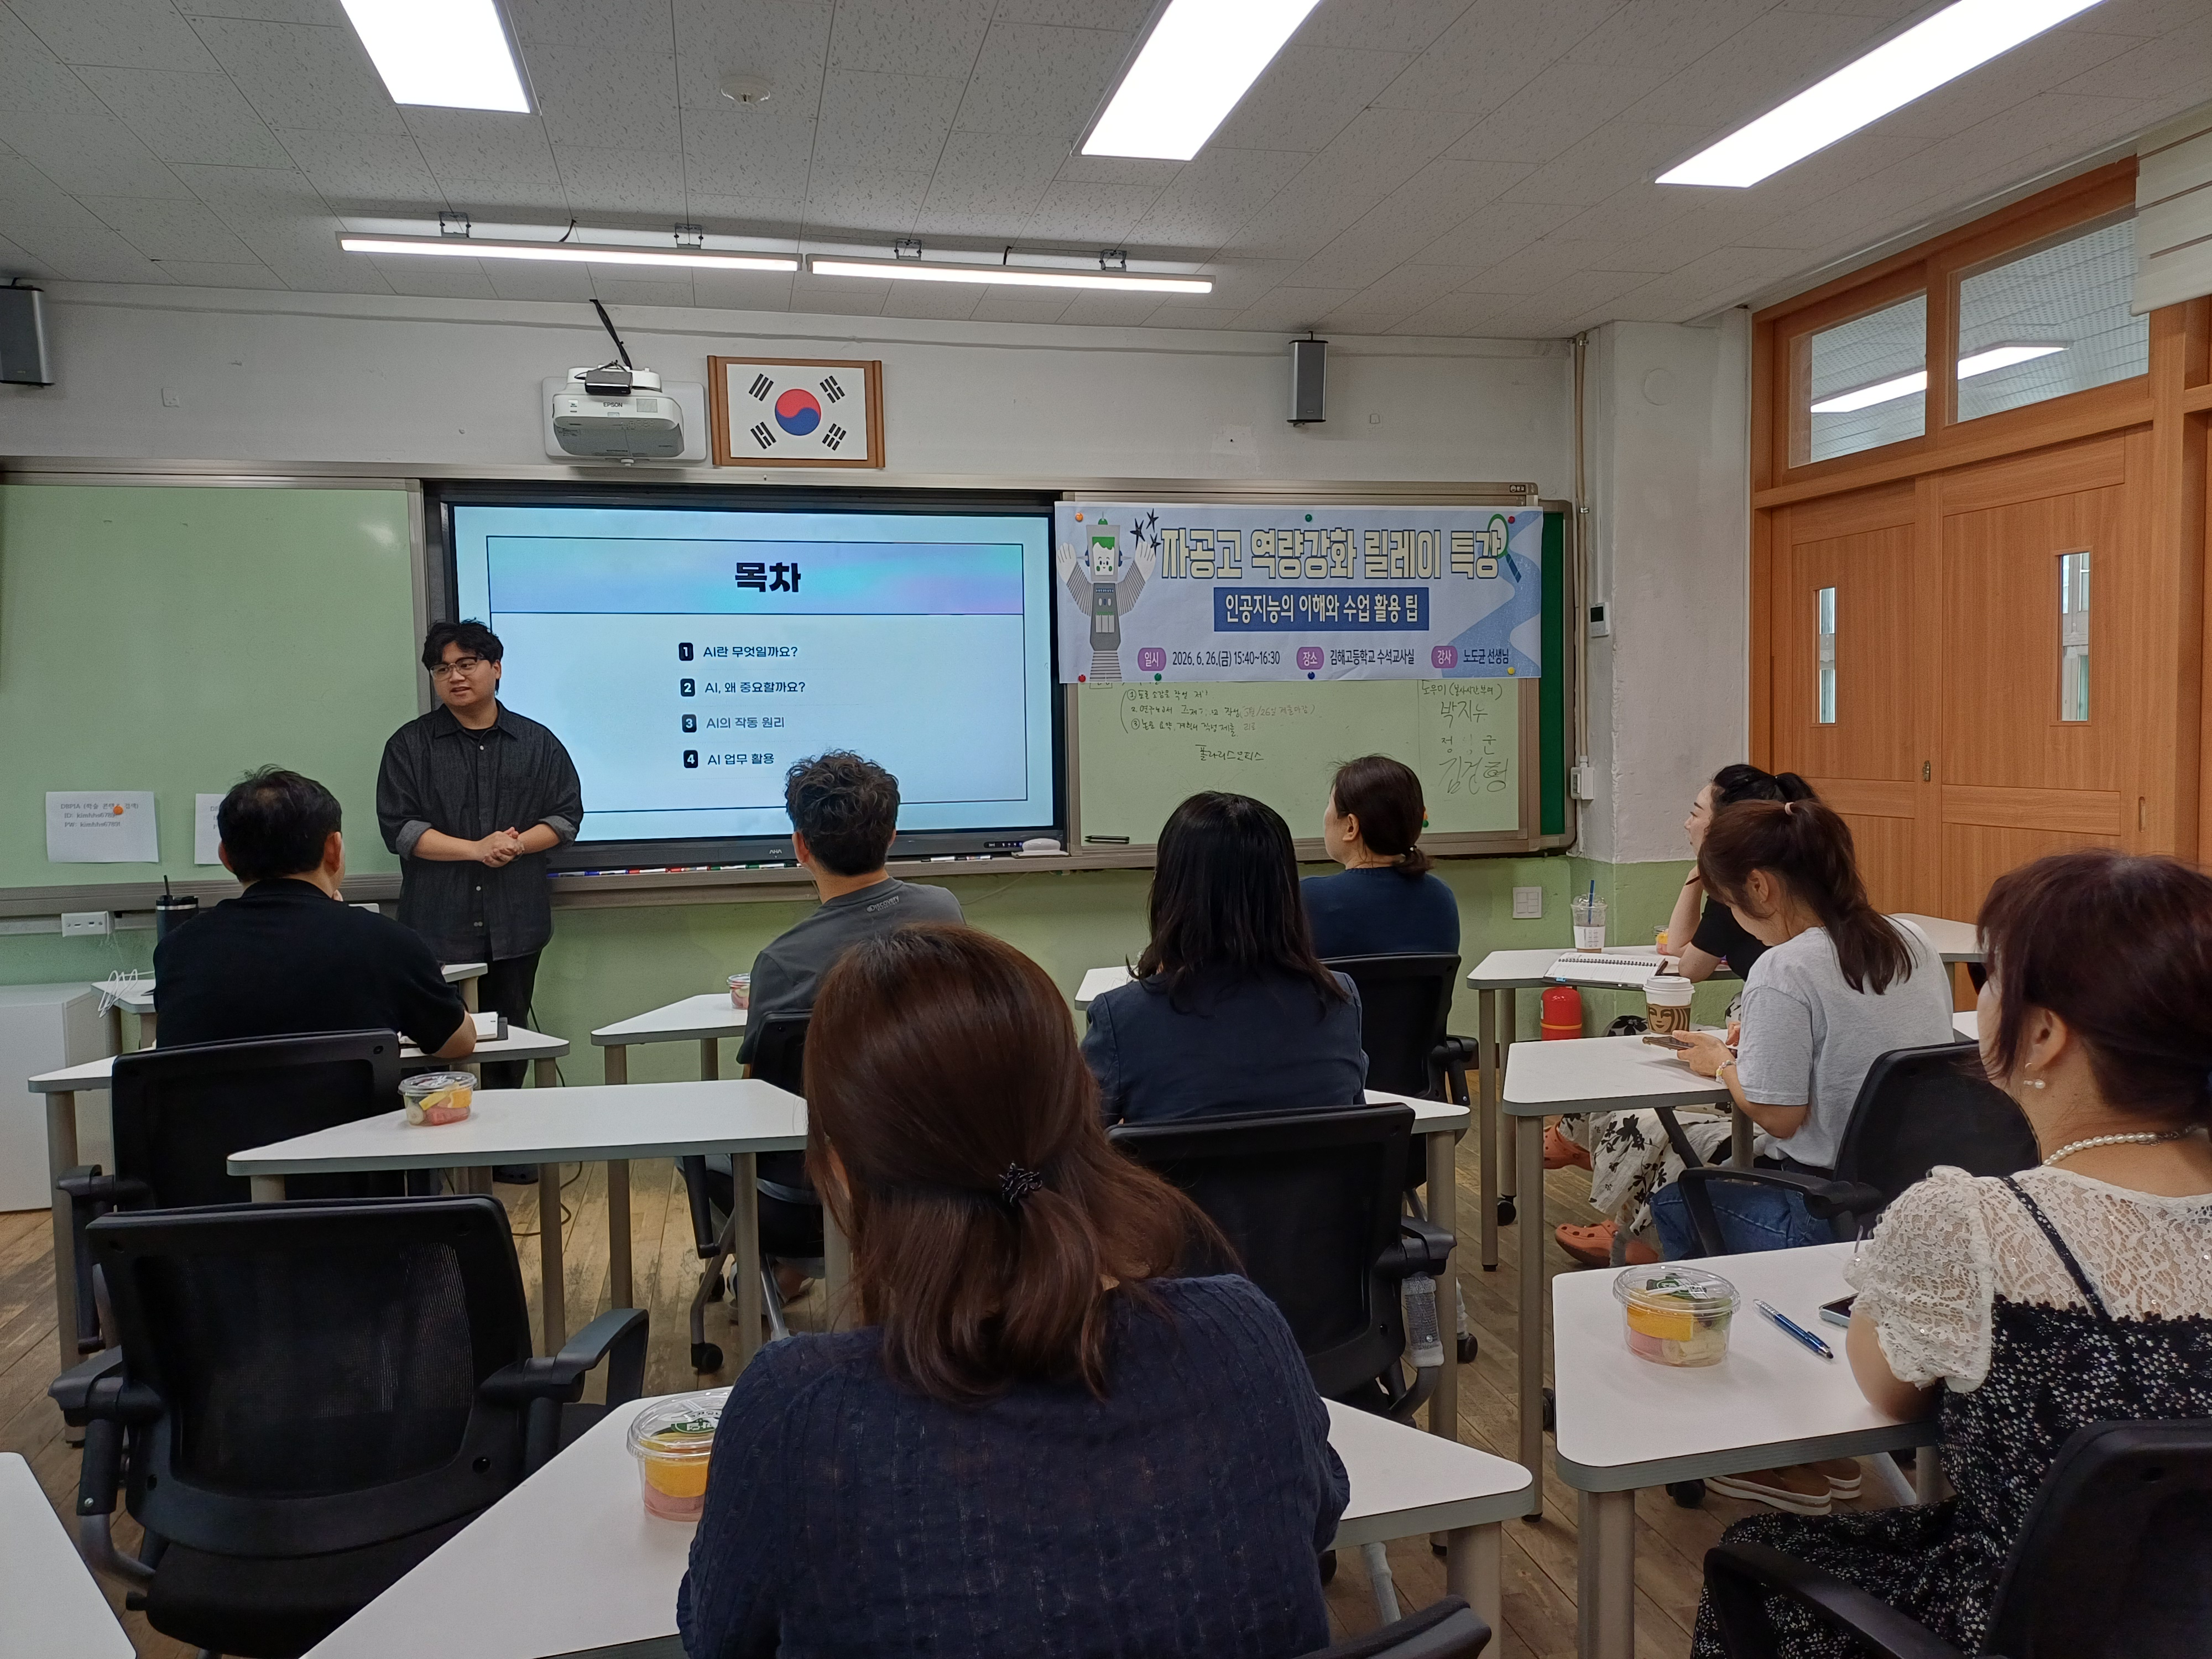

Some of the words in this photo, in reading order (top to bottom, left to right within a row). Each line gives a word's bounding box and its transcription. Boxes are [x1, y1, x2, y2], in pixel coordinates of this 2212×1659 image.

[1161, 528, 1242, 579] 자공고
[1250, 527, 1357, 579] 역량강화
[1364, 529, 1441, 579] 릴레이
[1451, 530, 1501, 580] 특강
[734, 562, 801, 592] 목차
[1225, 594, 1293, 623] 인공지능의
[1299, 594, 1339, 622] 이해와
[1343, 594, 1370, 622] 수업
[1374, 594, 1401, 623] 활용
[1405, 594, 1417, 622] 팁
[703, 646, 728, 658] AI란
[732, 646, 798, 658] 무엇일까요?
[1144, 651, 1159, 667] 일시
[1172, 651, 1194, 666] 2026.
[1197, 651, 1204, 665] 6.
[1234, 651, 1280, 665] 15:40~16:30
[1302, 651, 1318, 666] 장소
[1330, 649, 1376, 665] 김해고등학교
[1377, 649, 1415, 665] 수석교사실
[1437, 650, 1452, 665] 강사
[1463, 649, 1486, 664] 노도균
[1487, 649, 1509, 665] 선생님
[705, 683, 721, 694] AI,
[724, 682, 736, 693] 왜
[740, 681, 806, 693] 중요할까요?
[706, 718, 731, 729] AI의
[735, 717, 758, 728] 작동
[761, 717, 785, 728] 원리
[708, 755, 720, 765] AI
[724, 754, 748, 765] 업무
[752, 753, 774, 764] 활용
